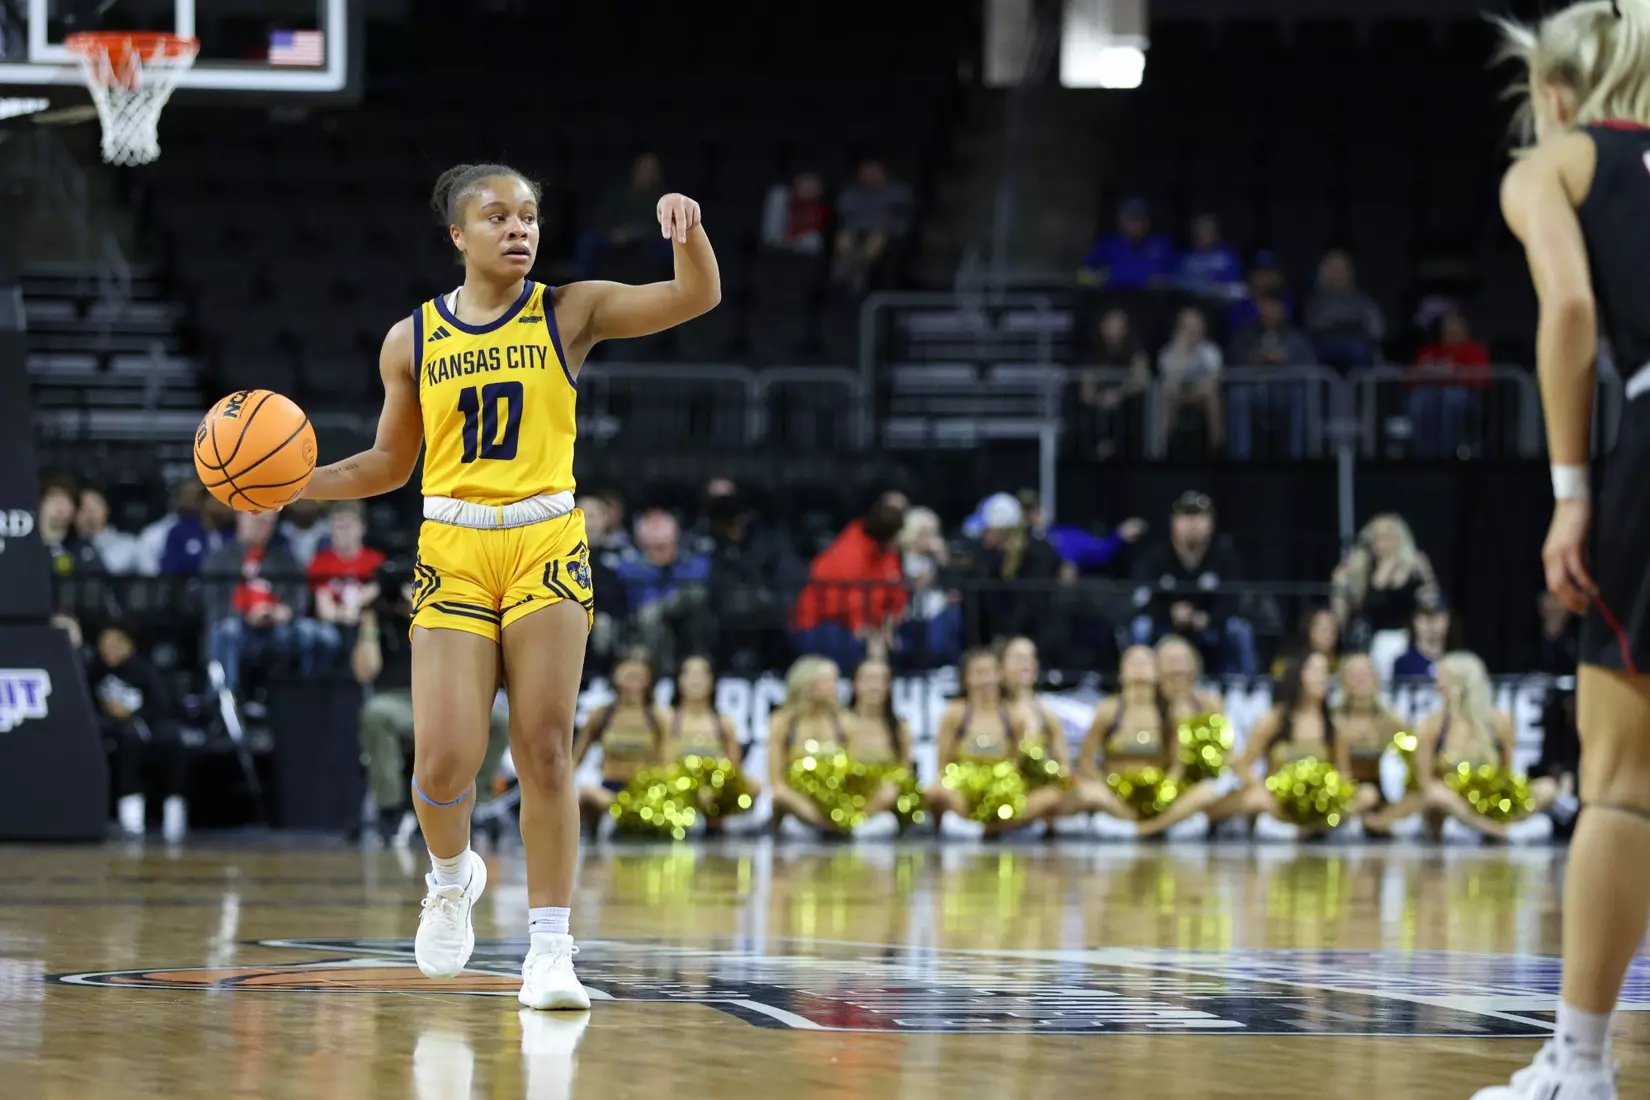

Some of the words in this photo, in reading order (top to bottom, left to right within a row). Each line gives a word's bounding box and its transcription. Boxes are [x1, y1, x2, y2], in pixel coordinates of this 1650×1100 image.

[427, 347, 501, 386] KANSAS
[506, 345, 547, 369] CITY
[457, 381, 524, 464] 10
